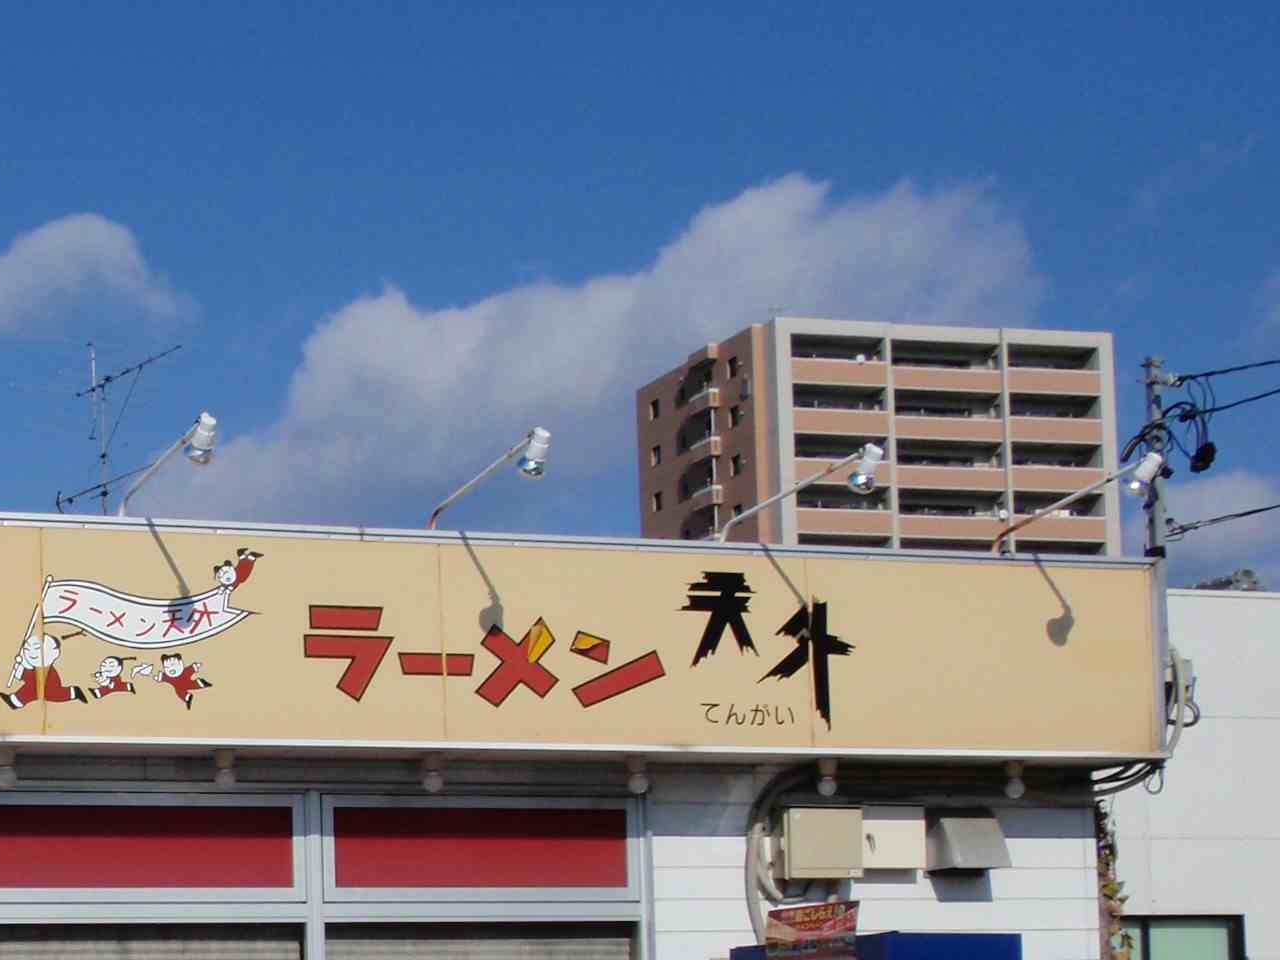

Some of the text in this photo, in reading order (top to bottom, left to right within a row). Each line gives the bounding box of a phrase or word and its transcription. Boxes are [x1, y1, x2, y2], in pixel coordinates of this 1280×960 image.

[58, 589, 219, 637] ラーメン天外
[303, 604, 666, 708] ラーメン
[700, 702, 796, 727] てんがい
